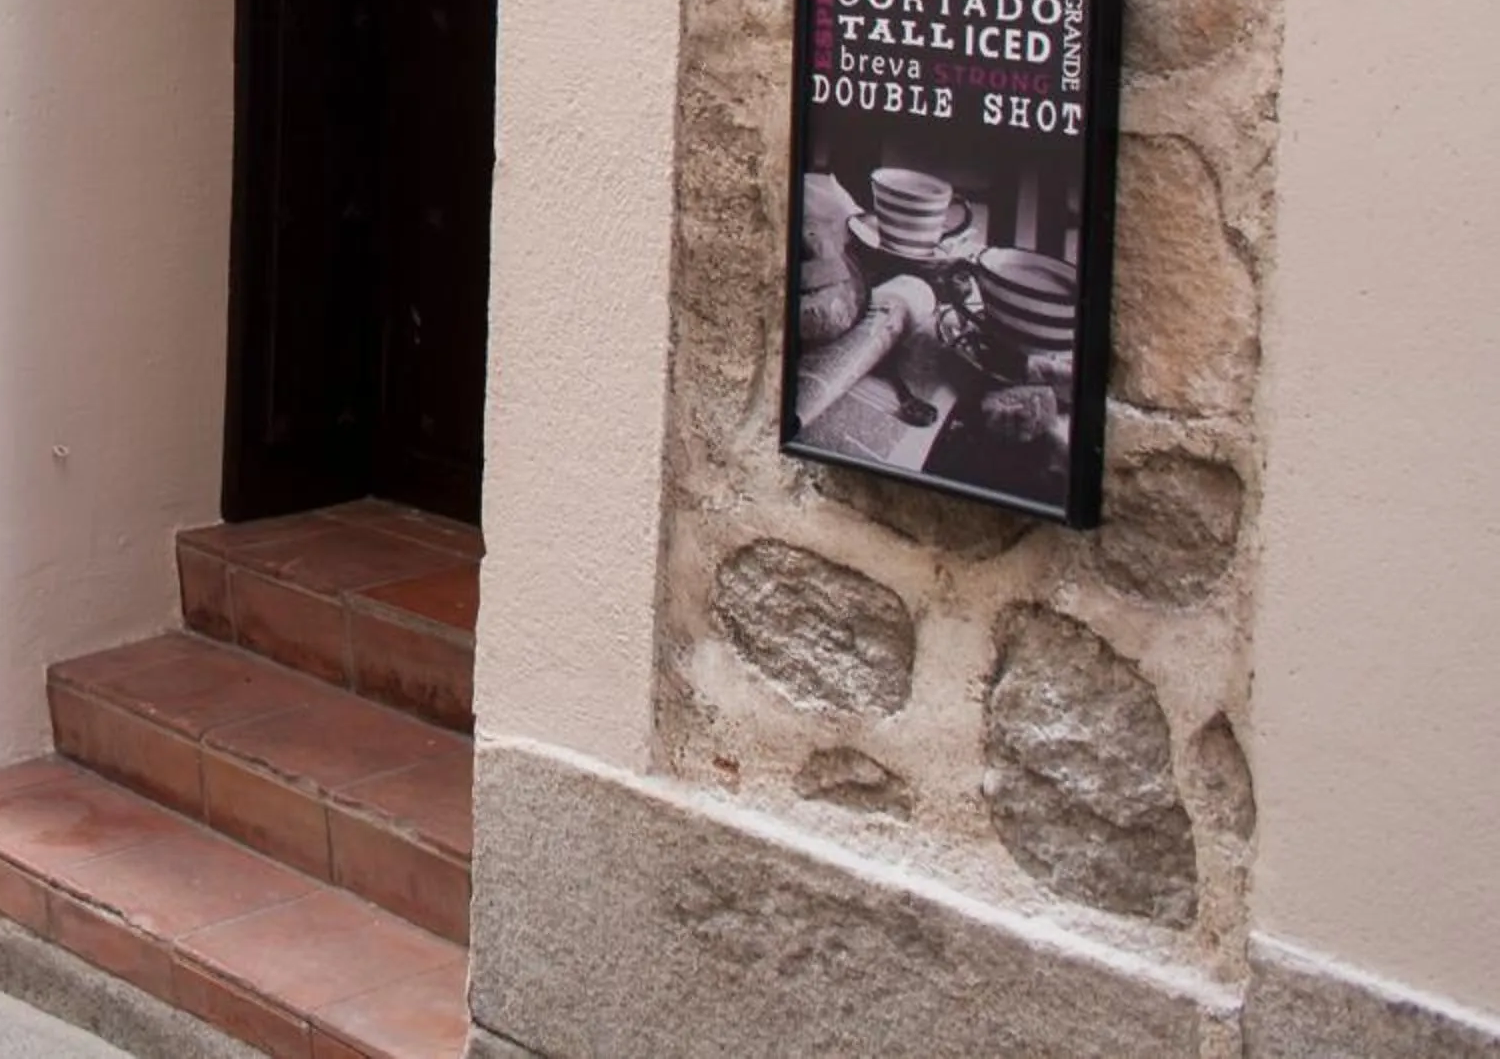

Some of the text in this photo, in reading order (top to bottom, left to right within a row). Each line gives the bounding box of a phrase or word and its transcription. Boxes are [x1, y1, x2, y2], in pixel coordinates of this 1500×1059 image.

[838, 14, 1051, 64] TALL ICED
[839, 44, 1050, 95] breva STRONG
[812, 73, 1083, 136] DOUBLE SHOT
